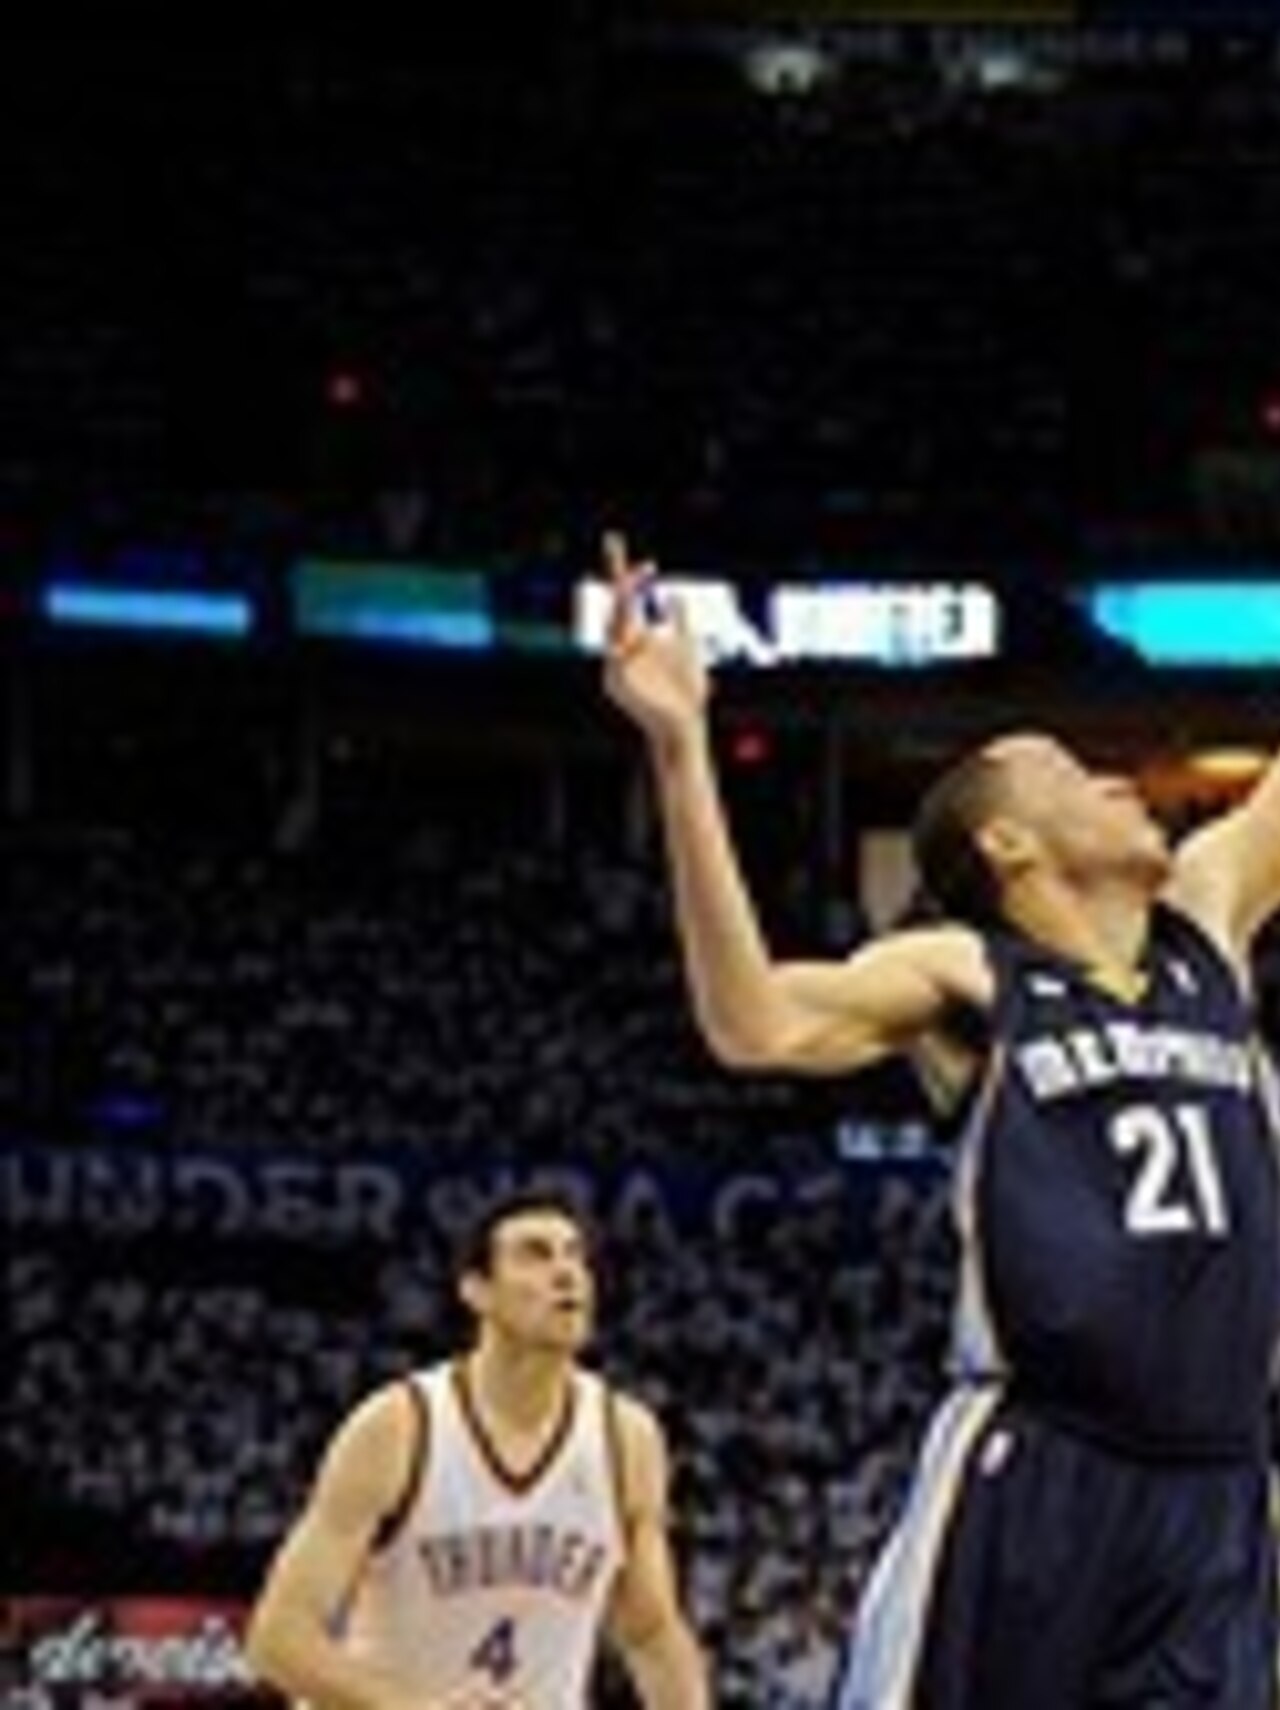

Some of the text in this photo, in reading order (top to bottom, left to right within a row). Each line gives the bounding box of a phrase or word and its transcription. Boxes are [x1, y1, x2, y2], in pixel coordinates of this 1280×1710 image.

[1110, 1104, 1228, 1236] 21
[416, 1520, 608, 1598] THUNDER
[468, 1614, 522, 1688] 4
